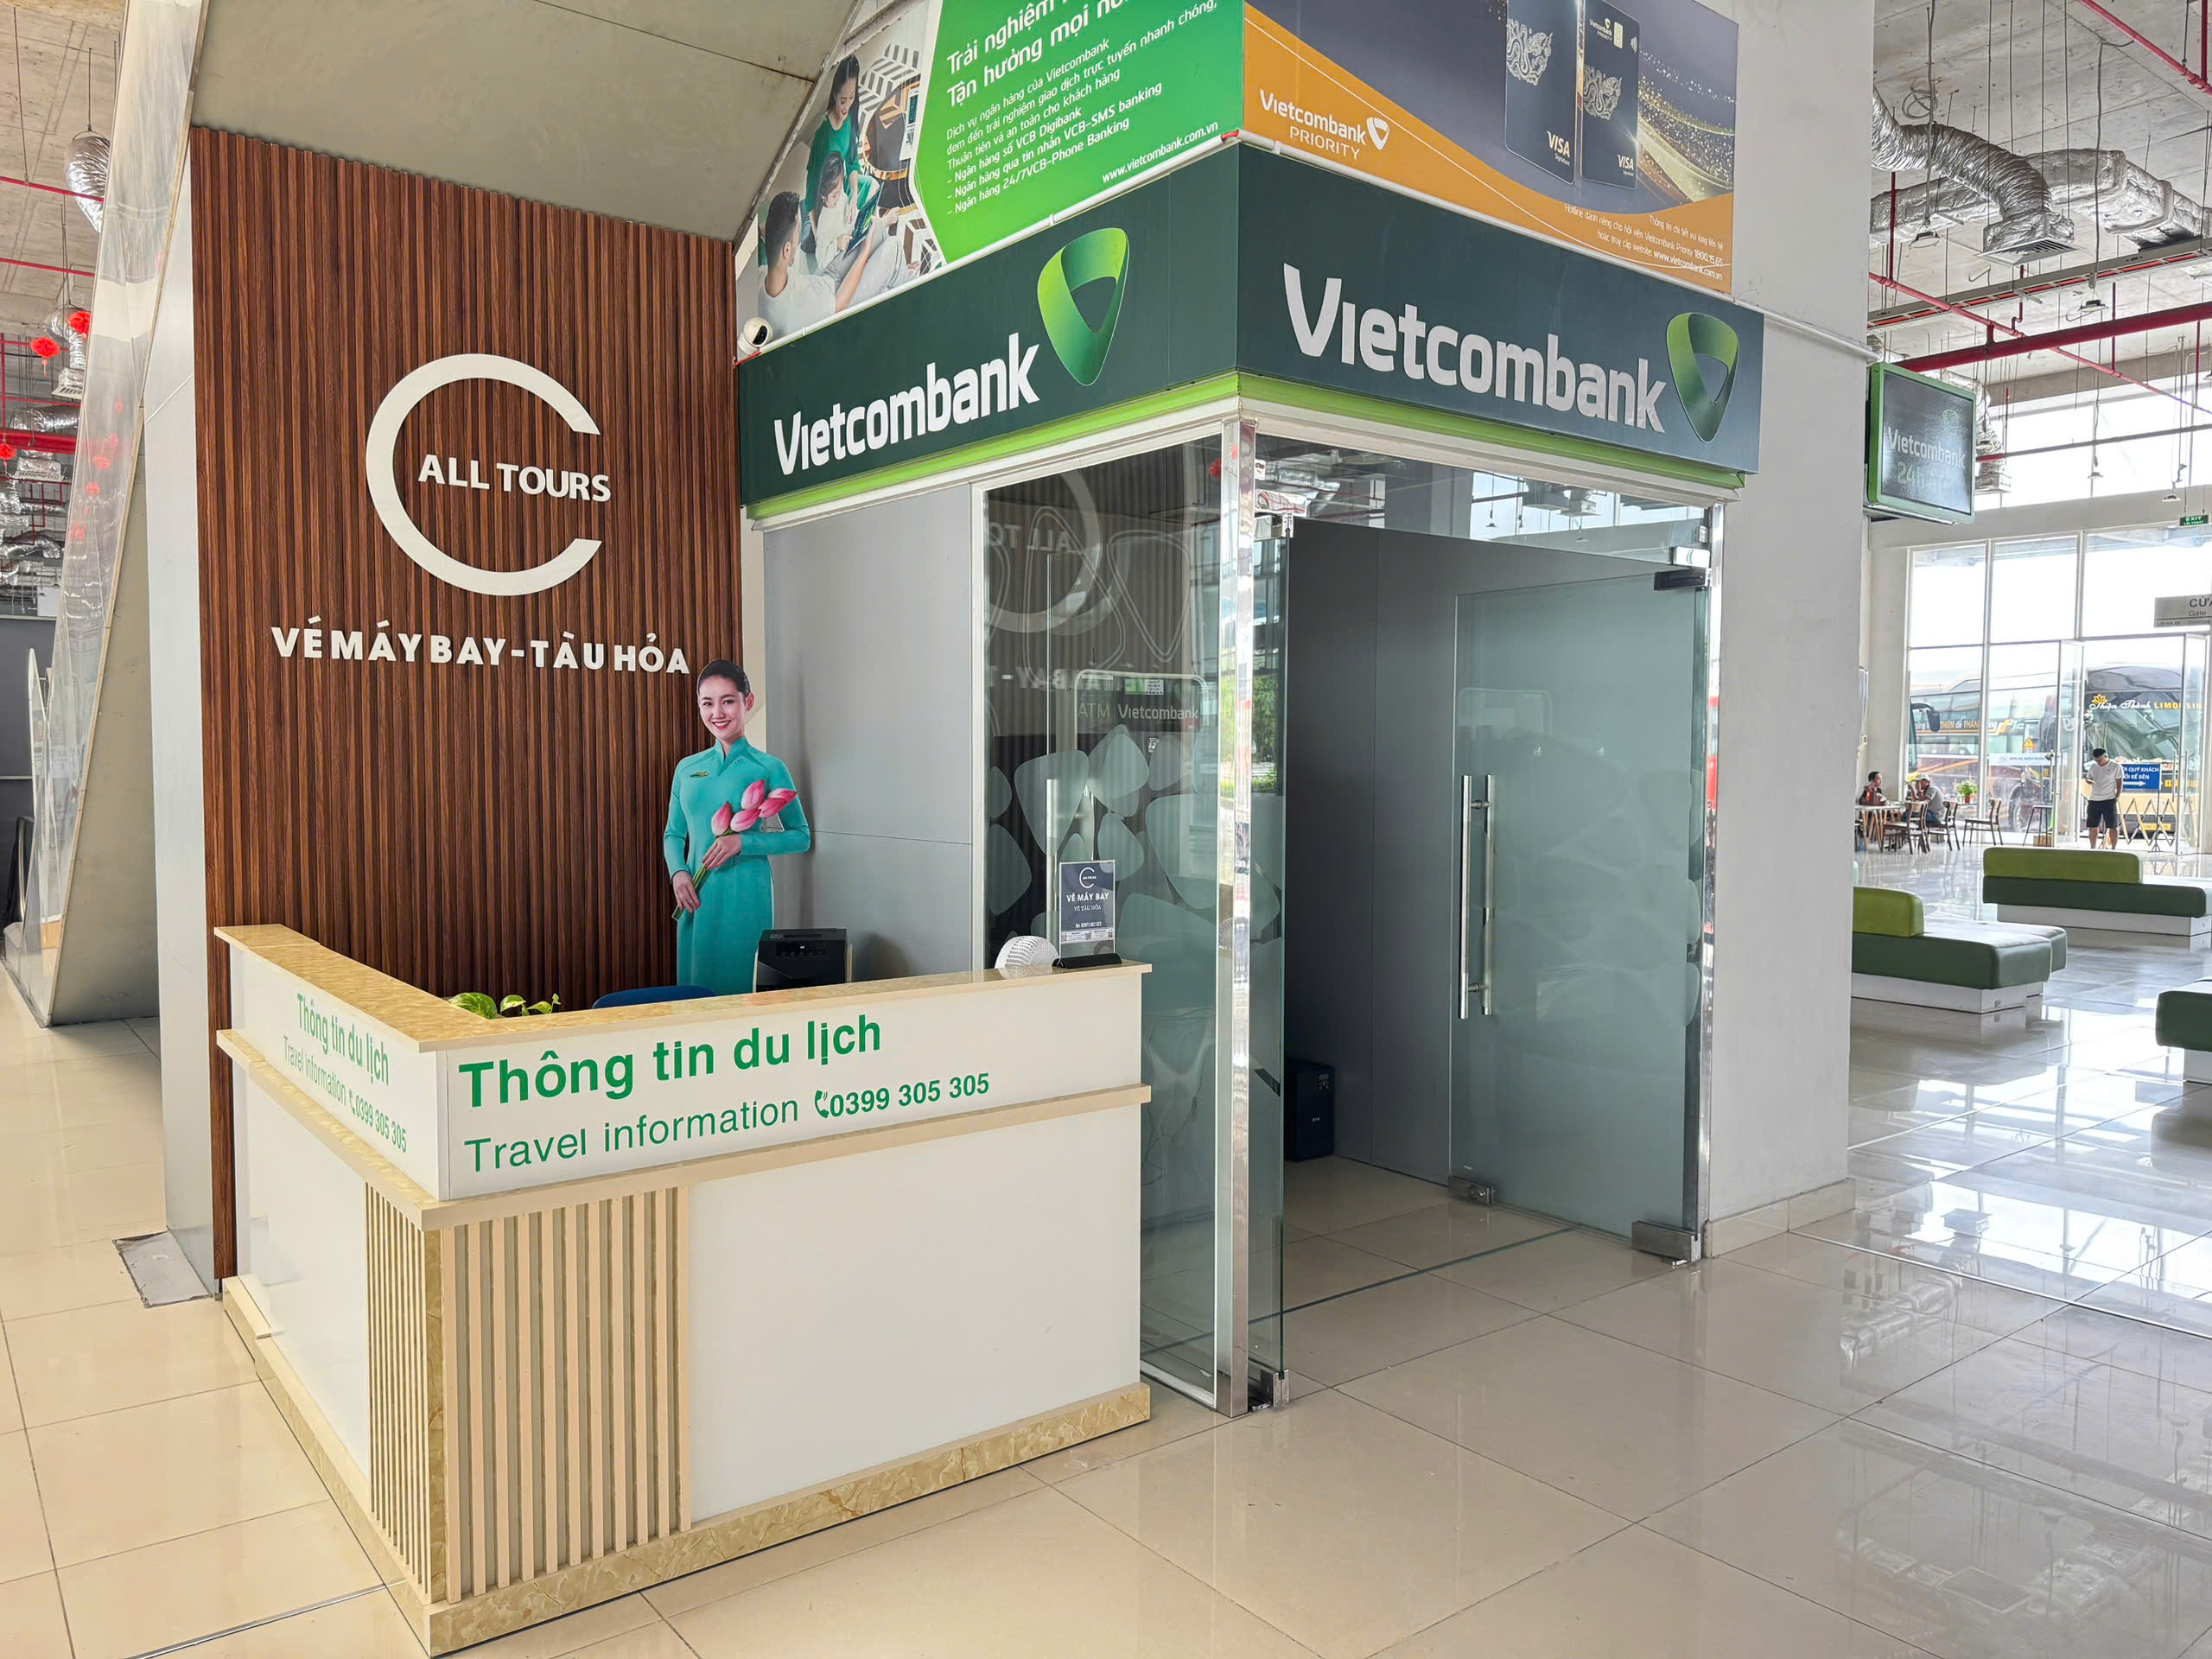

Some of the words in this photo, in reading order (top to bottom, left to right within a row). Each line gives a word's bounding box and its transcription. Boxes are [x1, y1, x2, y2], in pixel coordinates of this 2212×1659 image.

[947, 79, 976, 107] Tận
[984, 37, 1042, 87] hưởng
[1051, 3, 1089, 47] mọi
[947, 40, 977, 74] Trải
[947, 139, 965, 156] đem
[968, 127, 983, 143] đến
[986, 118, 1001, 133] trải
[1002, 99, 1036, 124] nghiệm
[1038, 87, 1058, 106] giao
[1061, 73, 1080, 92] dịch
[1084, 60, 1104, 79] trực
[1107, 40, 1137, 66] tuyến
[1140, 19, 1174, 47] nhanh
[1178, 0, 1217, 26] chóng,
[947, 124, 964, 140] Dịch
[968, 116, 977, 128] vụ
[980, 103, 1001, 122] ngân
[1003, 89, 1025, 108] hàng
[1027, 77, 1043, 93] của
[1046, 38, 1110, 82] Vietcombank
[994, 132, 1004, 145] và
[1007, 126, 1017, 138] an
[1020, 113, 1040, 130] toàn
[1043, 102, 1059, 118] cho
[1063, 85, 1092, 107] khách
[1096, 68, 1121, 90] hàng
[1259, 89, 1367, 146] Vietcombank
[955, 180, 976, 198] Ngân
[979, 167, 1001, 185] hàng
[1002, 157, 1020, 175] qua
[1022, 149, 1034, 163] tin
[1037, 135, 1061, 156] nhắn
[1119, 82, 1162, 113] banking
[955, 164, 976, 182] Ngân
[979, 151, 1001, 170] hàng
[1003, 140, 1014, 156] số
[1016, 130, 1036, 149] VCB
[1039, 106, 1082, 137] Digibank
[955, 195, 976, 213] Ngân
[979, 182, 1001, 201] hàng
[1087, 117, 1129, 147] Banking
[1102, 121, 1218, 183] www.vietcombank.com.vn
[1289, 125, 1361, 160] PRIORITY
[1547, 130, 1570, 158] VISA
[1618, 154, 1634, 171] VISA
[1564, 202, 1584, 218] Hotline
[1599, 216, 1612, 230] riêng
[1613, 221, 1624, 232] cho
[1644, 232, 1675, 250] Vietcombank
[1676, 242, 1694, 257] Priority
[1611, 235, 1622, 247] truy
[1649, 214, 1664, 231] Thông
[1283, 262, 1668, 435] Vietcombank
[773, 332, 1040, 476] Vietcombank
[418, 454, 490, 490] ALL
[496, 462, 612, 503] TOURS
[1887, 425, 1967, 471] Vietcombank
[2189, 594, 2212, 608] CỬ
[270, 614, 323, 659] VÉ
[330, 619, 423, 663] MÁY
[614, 632, 690, 675] HỎA
[1077, 702, 1110, 719] ATM
[1117, 703, 1199, 720] Vietcombank
[1066, 893, 1076, 902] VÉ
[1077, 892, 1094, 902] MÁY
[1096, 892, 1109, 900] BAY
[297, 993, 328, 1055] Thông
[332, 1014, 345, 1057] tin
[348, 1024, 363, 1067] du
[366, 1033, 389, 1086] lịch
[459, 1051, 634, 1109] Thông
[653, 1040, 715, 1081] tin
[733, 1028, 790, 1071] du
[807, 1014, 881, 1067] lịch
[283, 1035, 304, 1071] Travel
[305, 1053, 346, 1106] information
[355, 1095, 374, 1127] 0399
[375, 1109, 390, 1140] 305
[391, 1121, 407, 1153] 305
[464, 1128, 588, 1173] Travel
[604, 1098, 799, 1153] information
[829, 1089, 892, 1118] 0399
[898, 1079, 942, 1108] 305
[949, 1072, 991, 1101] 305
